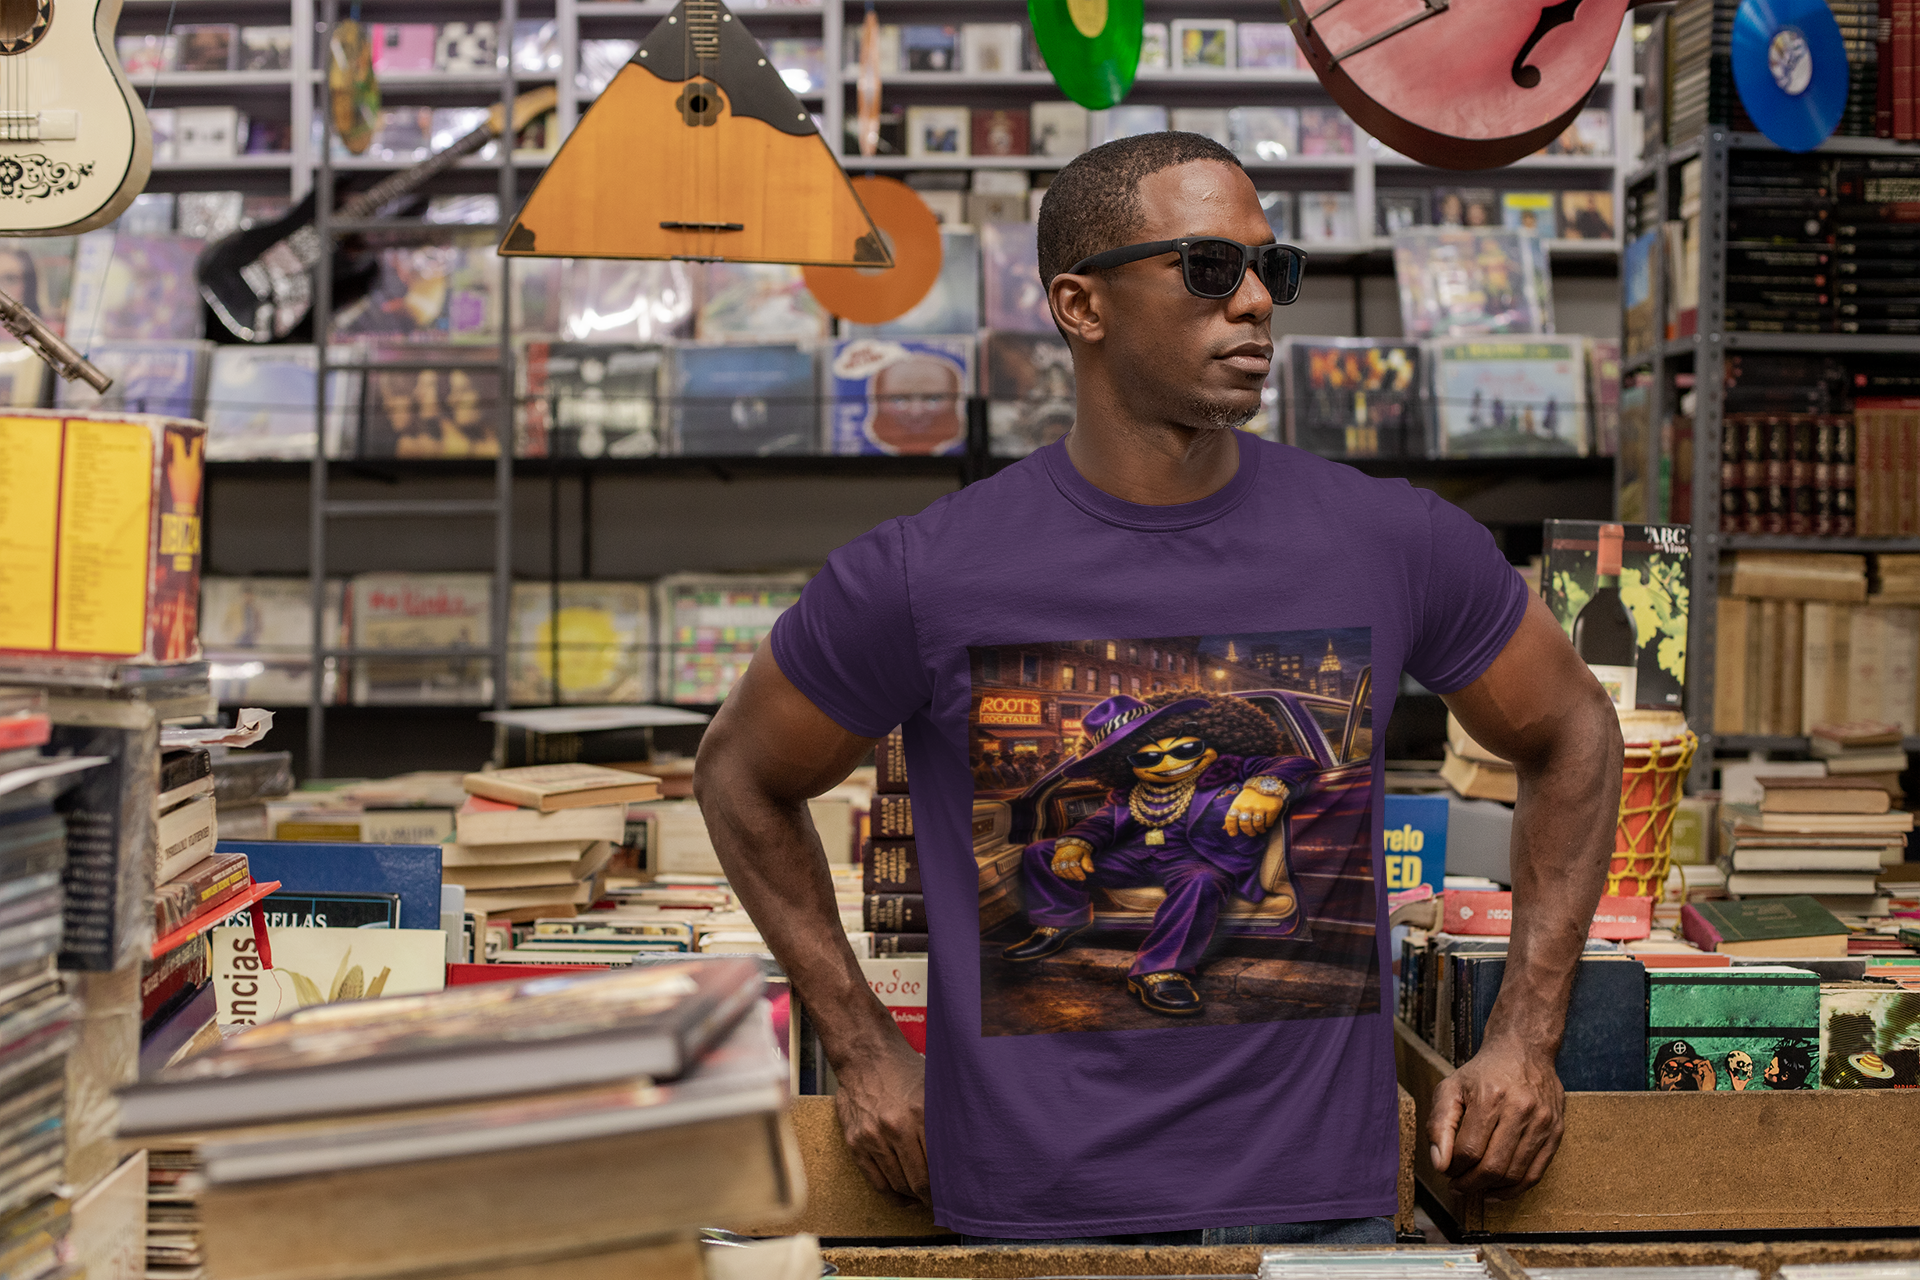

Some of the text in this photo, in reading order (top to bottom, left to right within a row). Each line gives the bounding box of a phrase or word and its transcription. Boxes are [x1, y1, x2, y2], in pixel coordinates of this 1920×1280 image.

[1308, 348, 1414, 390] KISS
[1648, 526, 1686, 545] ABC
[982, 697, 1040, 713] ROOT'S
[881, 797, 889, 835] AMADO
[873, 847, 882, 884] AMADO
[1385, 855, 1422, 888] ED
[223, 937, 259, 1025] ncias
